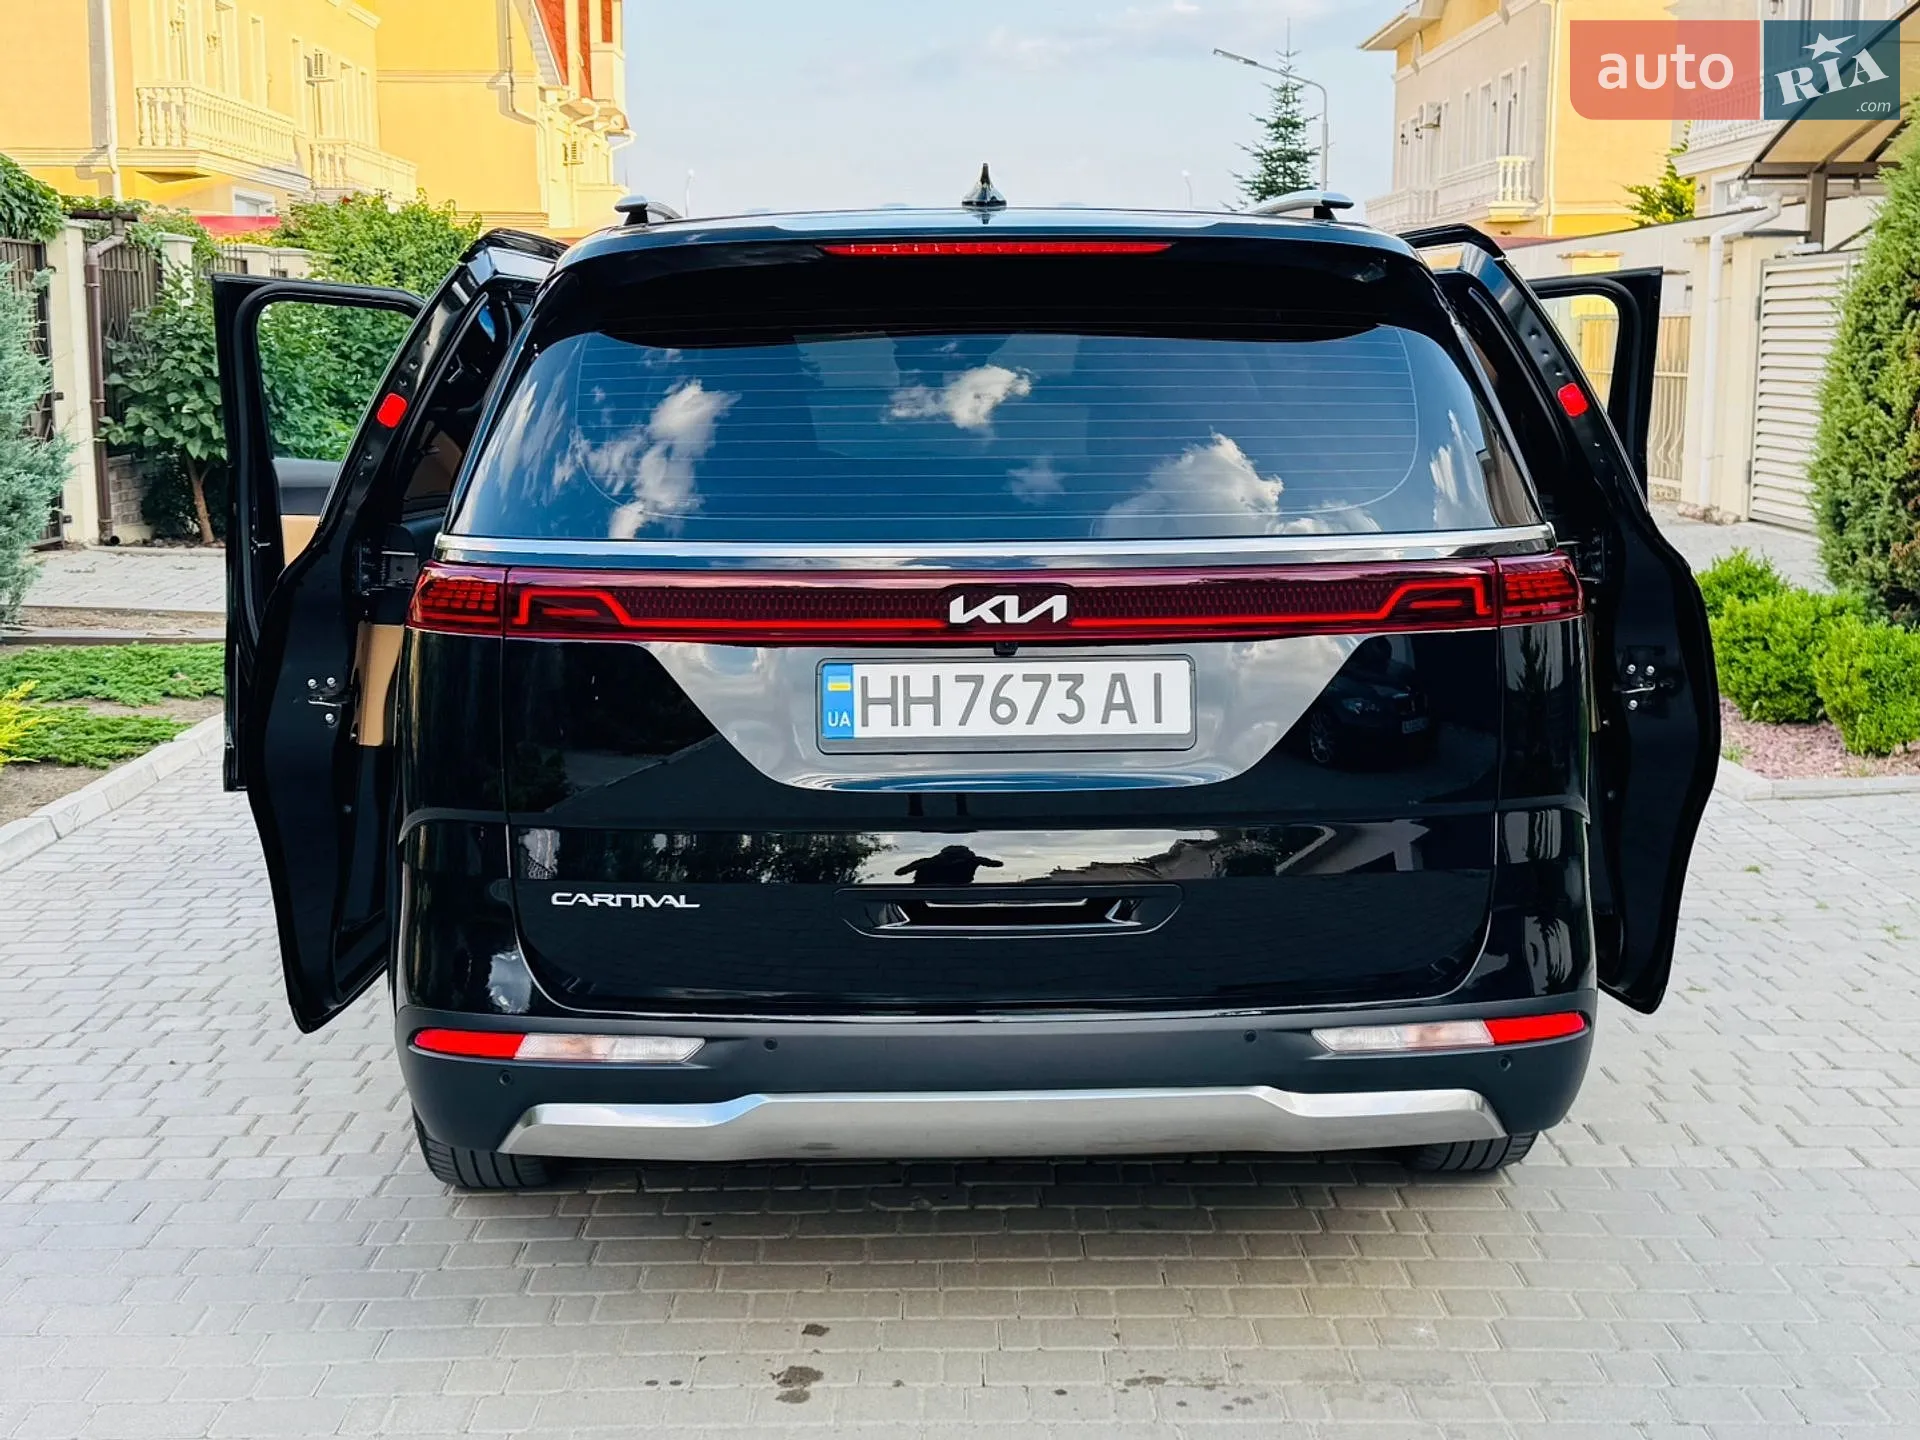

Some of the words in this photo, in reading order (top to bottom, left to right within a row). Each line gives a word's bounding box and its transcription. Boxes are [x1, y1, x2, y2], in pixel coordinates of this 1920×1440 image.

[949, 595, 1067, 623] KIA
[827, 711, 852, 727] UA
[551, 892, 700, 908] CARNIVAL
